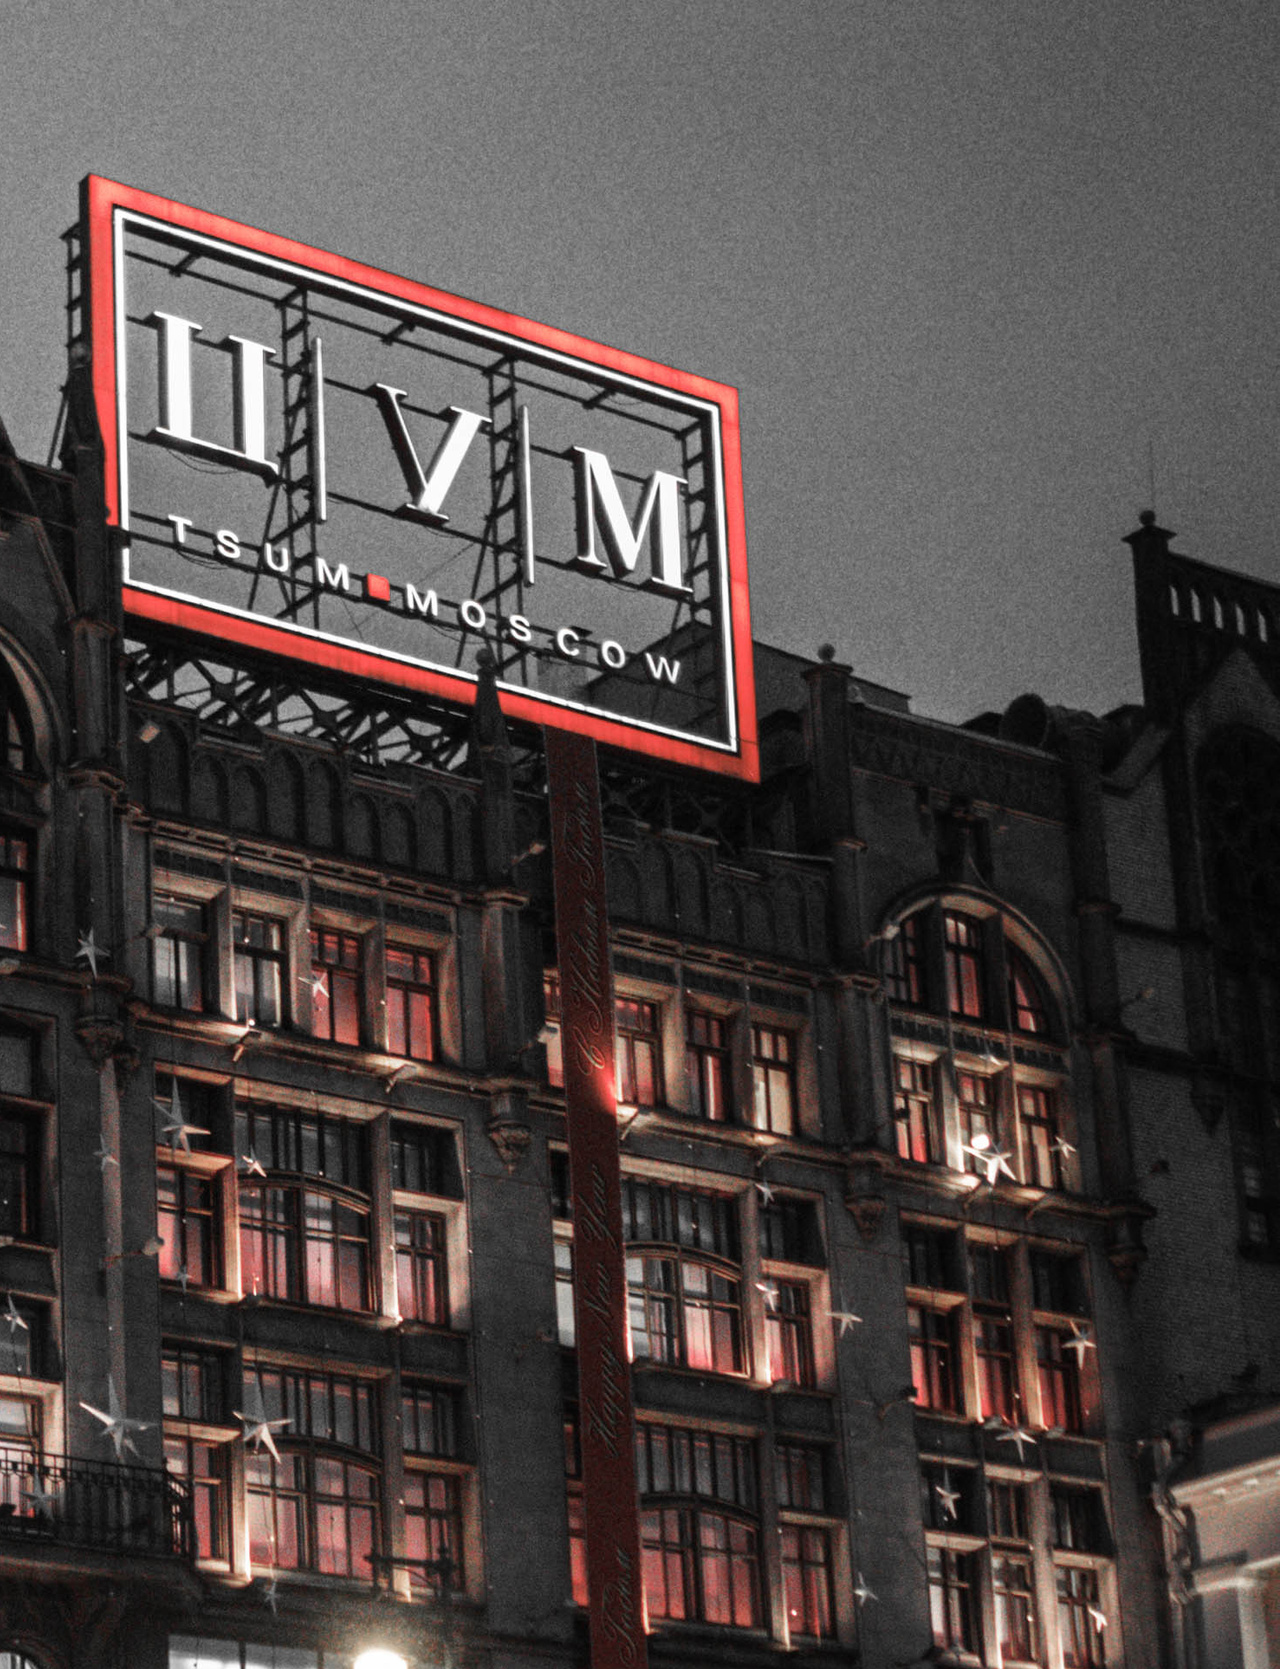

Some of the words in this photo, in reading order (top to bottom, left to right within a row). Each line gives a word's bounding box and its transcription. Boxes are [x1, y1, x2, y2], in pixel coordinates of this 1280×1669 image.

[168, 515, 350, 591] TSUM
[406, 583, 681, 684] MOSCOW
[578, 1163, 618, 1248] Year
[583, 1262, 613, 1341] New
[586, 1345, 625, 1458] Happy
